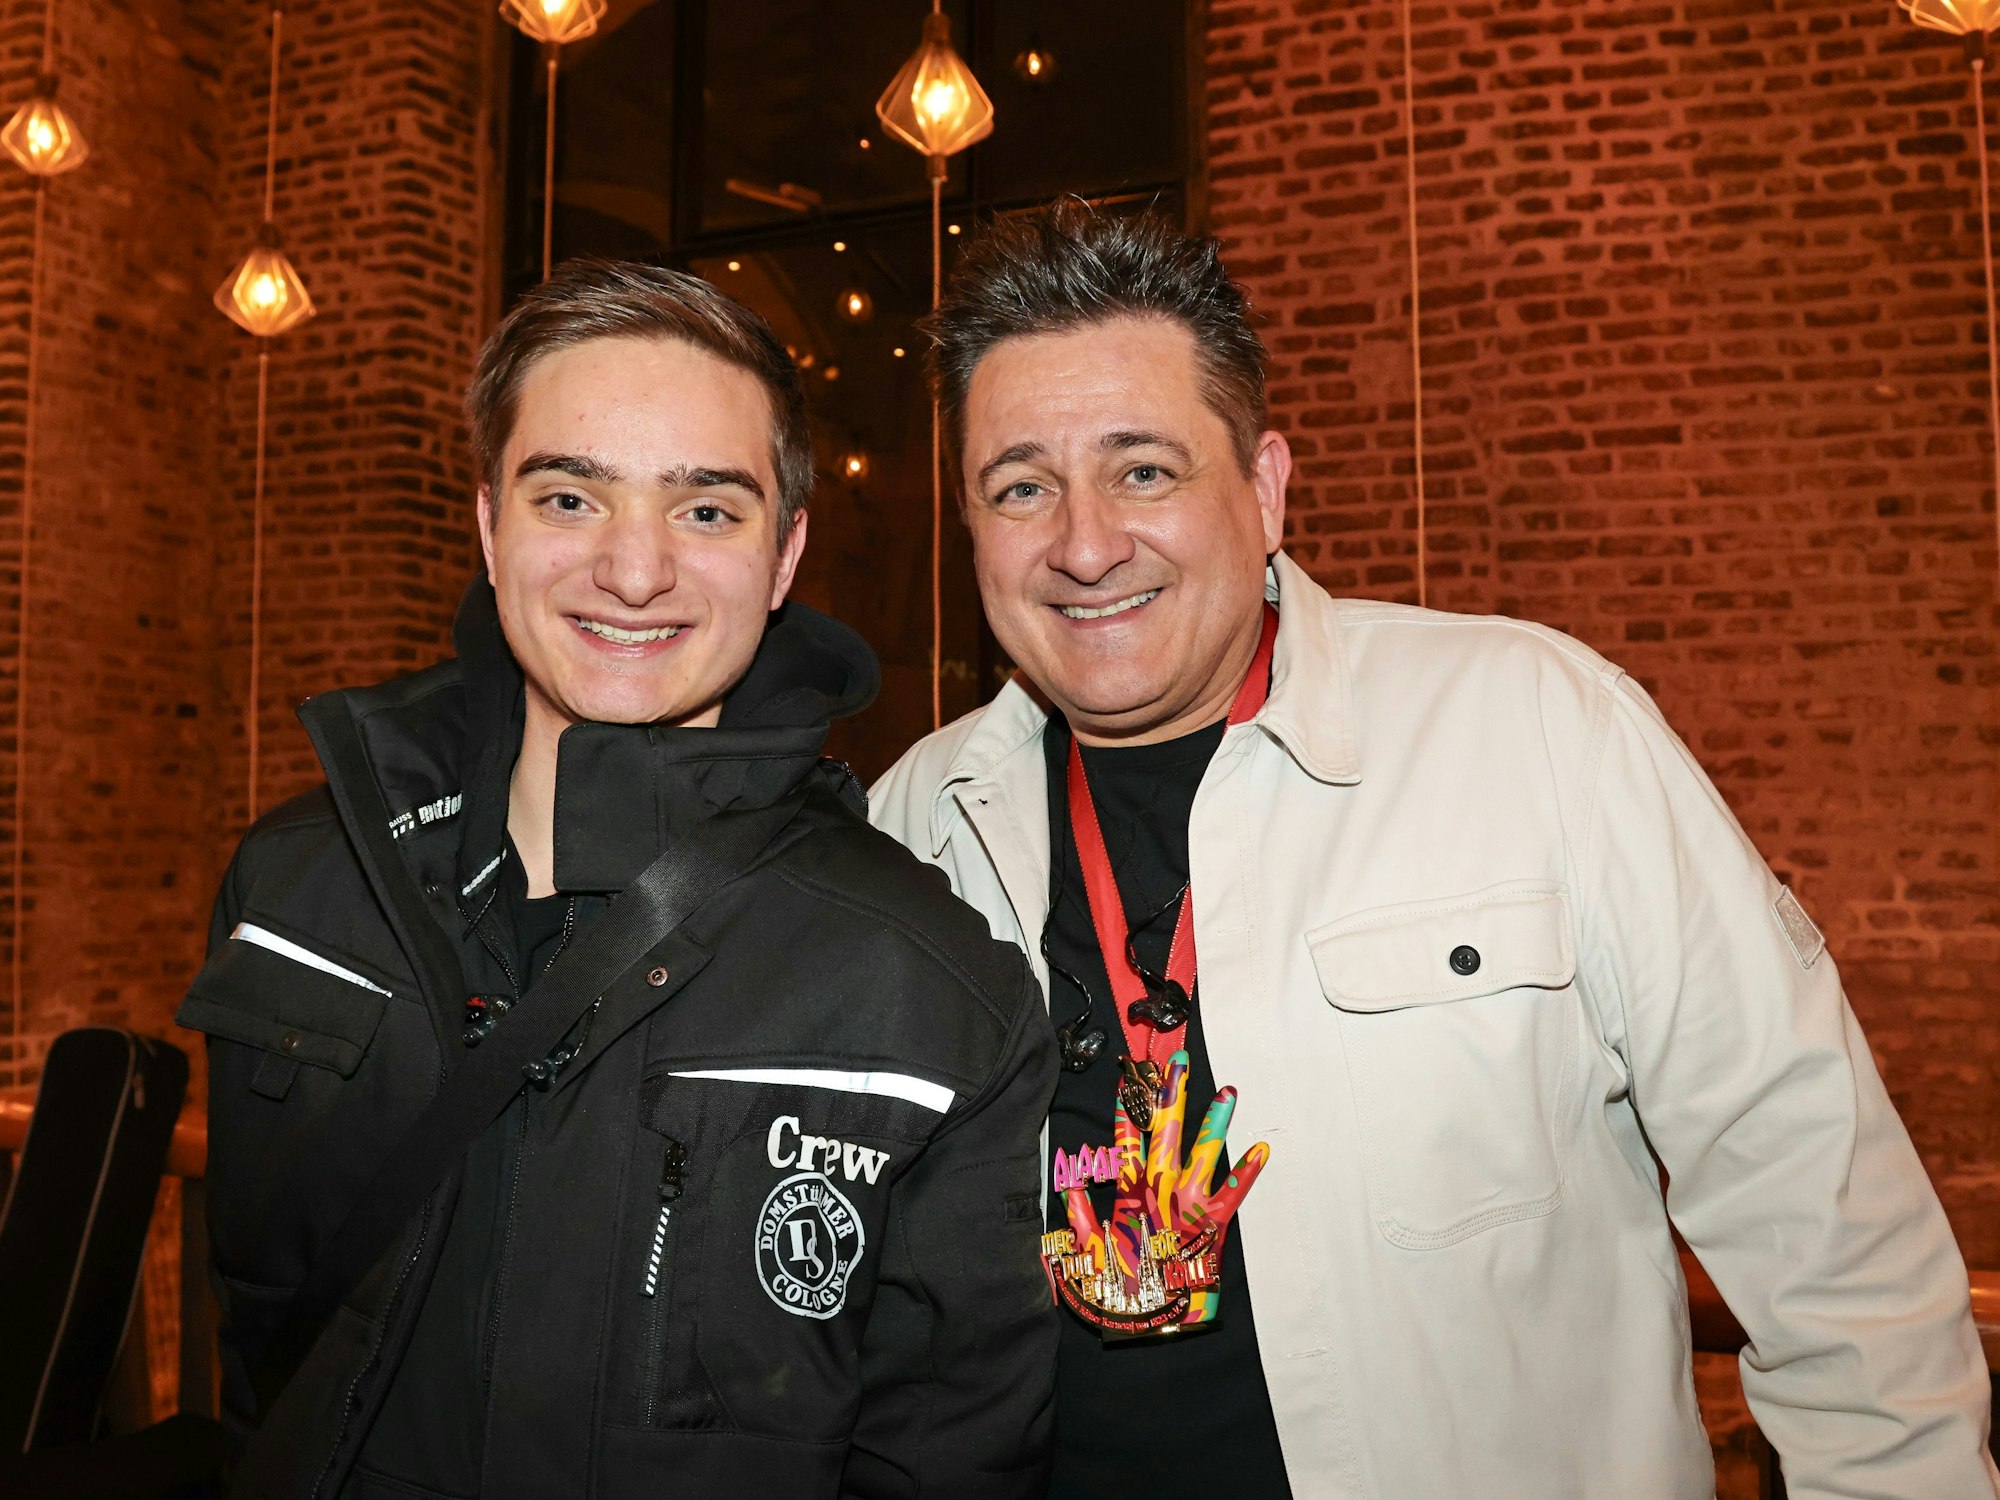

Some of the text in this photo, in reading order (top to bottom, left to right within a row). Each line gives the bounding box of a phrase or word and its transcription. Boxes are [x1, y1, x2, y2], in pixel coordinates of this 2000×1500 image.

[767, 1115, 891, 1186] Crew
[1054, 1143, 1126, 1192] ALAAF
[1041, 1229, 1073, 1257] MER
[772, 1259, 848, 1311] COLOGNE
